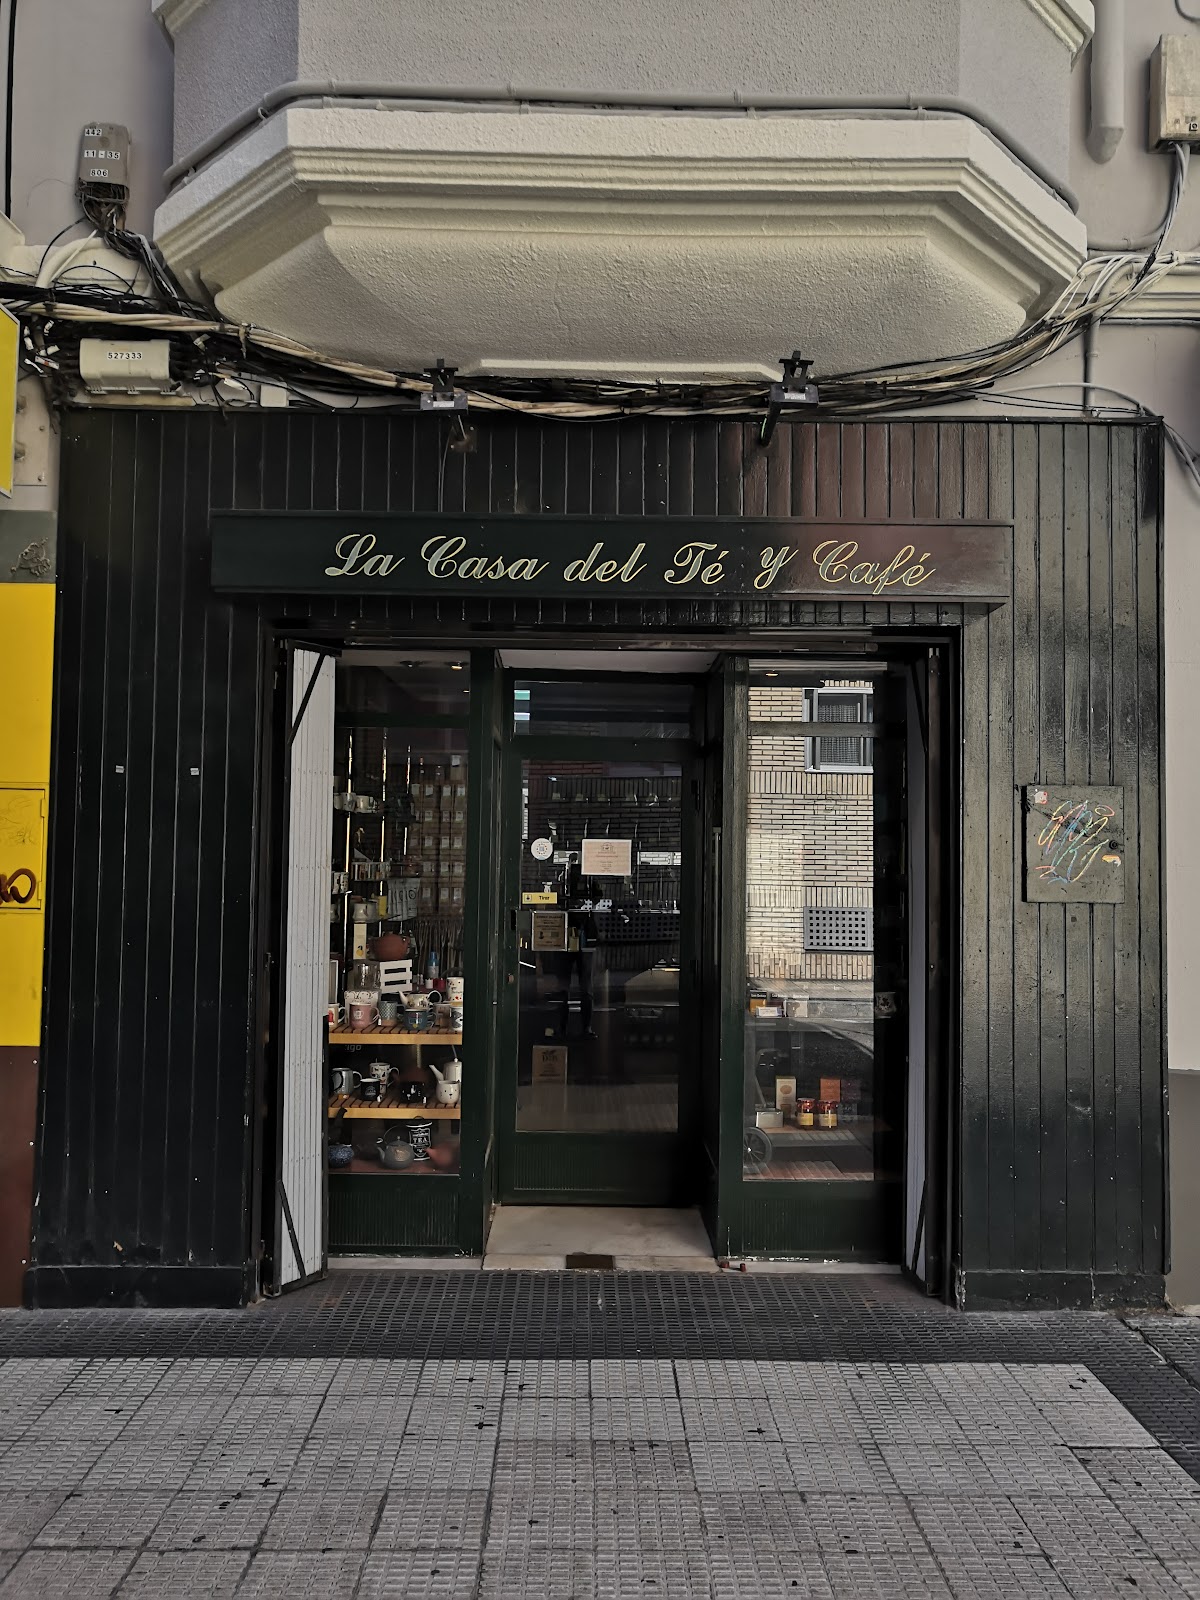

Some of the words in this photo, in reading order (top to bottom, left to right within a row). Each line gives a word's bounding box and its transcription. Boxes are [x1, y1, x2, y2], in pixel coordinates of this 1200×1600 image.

[91, 169, 108, 177] 806
[107, 352, 142, 360] 527333
[324, 533, 406, 577] La
[420, 535, 550, 580] Casa
[563, 542, 648, 582] del
[664, 541, 729, 585] Té
[753, 546, 799, 590] y
[812, 540, 937, 595] Café
